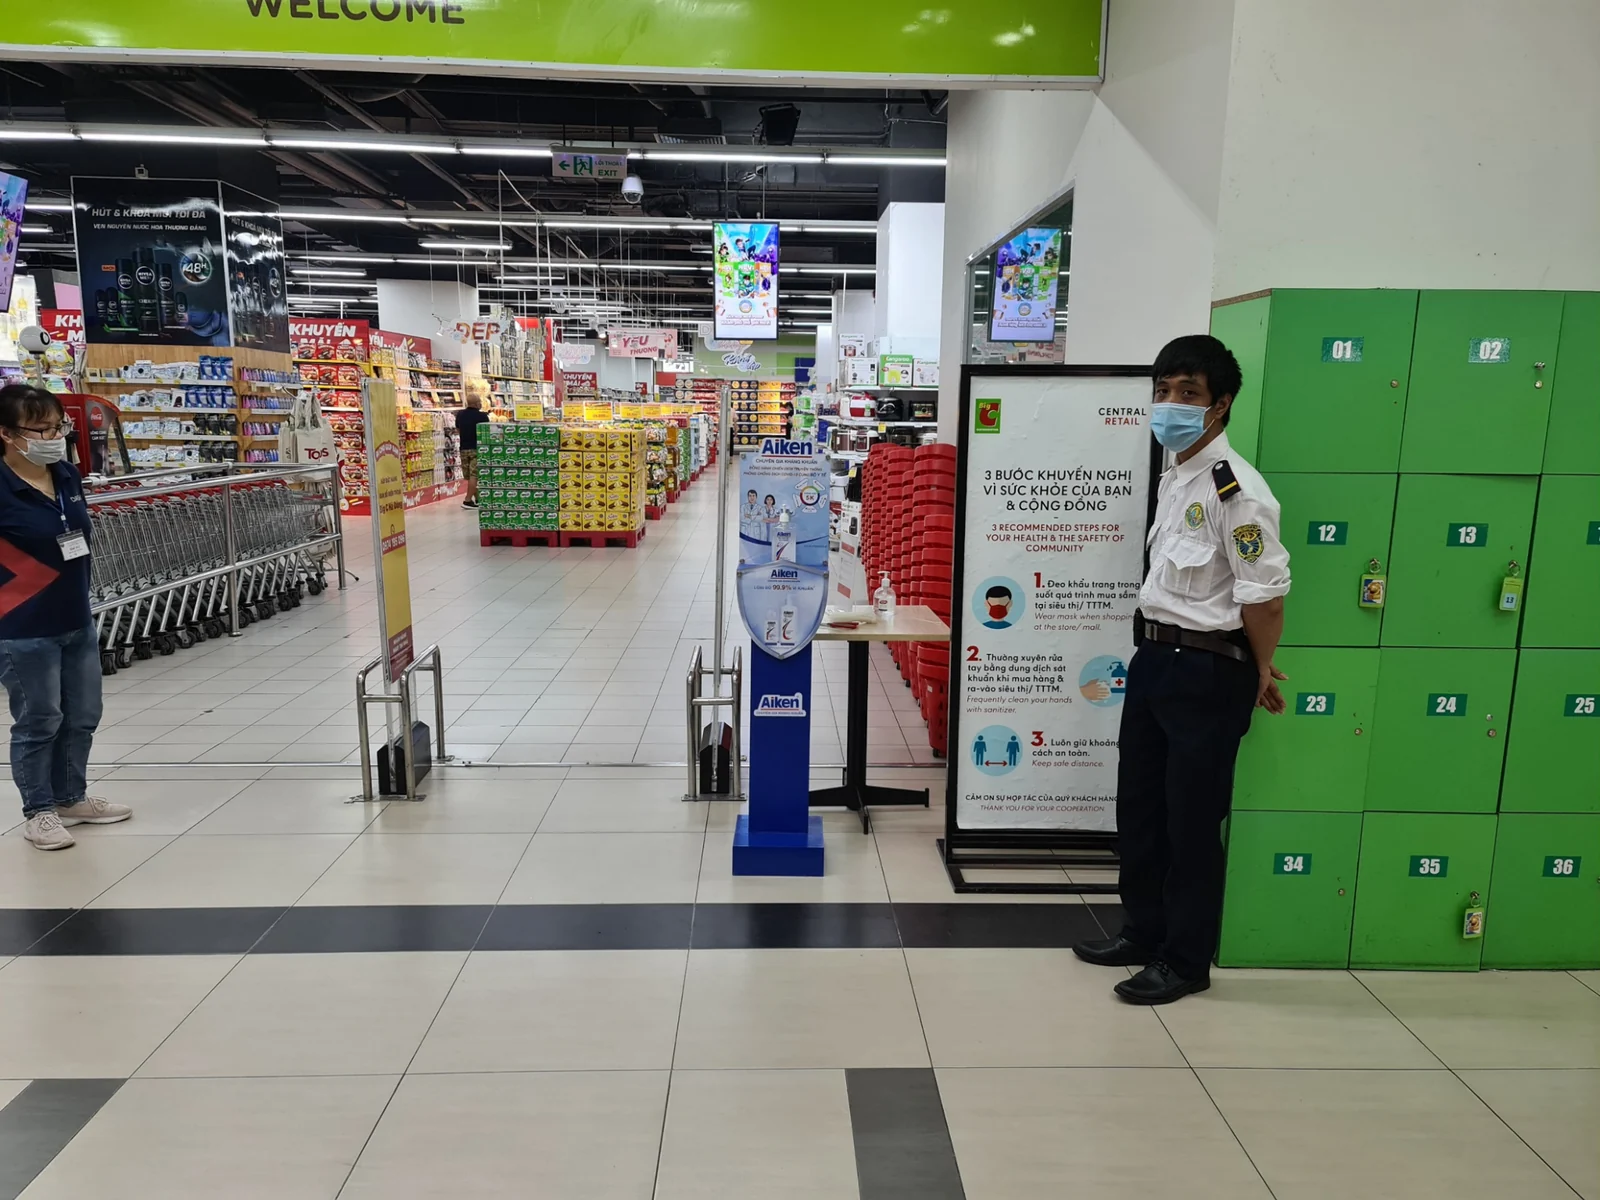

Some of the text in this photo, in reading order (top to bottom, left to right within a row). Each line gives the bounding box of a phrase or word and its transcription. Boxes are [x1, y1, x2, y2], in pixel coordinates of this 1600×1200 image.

[246, 0, 465, 24] WELCOME
[1332, 340, 1352, 359] 01
[1479, 341, 1502, 360] 02
[1098, 408, 1147, 416] CENTRAL
[1105, 417, 1140, 425] RETAIL
[762, 438, 813, 455] Aiken
[984, 465, 1132, 483] 3 BƯỚC KHUYẾN NGHỊ
[983, 482, 1132, 499] VÌ SỨC KHỎE CỦA BẠN
[1006, 500, 1015, 511] &
[1019, 498, 1060, 513] CỘNG
[1318, 524, 1336, 542] 12
[1458, 526, 1477, 543] 13
[771, 569, 798, 577] Aiken
[1034, 572, 1045, 588] 1.
[1068, 578, 1089, 588] khẩu
[1092, 581, 1114, 590] trang
[1118, 581, 1140, 590] trong
[1036, 590, 1053, 598] suốt
[1056, 591, 1072, 600] quá
[1035, 602, 1046, 611] tại
[1068, 601, 1084, 611] thị/
[966, 646, 982, 661] 2.
[986, 654, 1019, 663] Thường
[1021, 654, 1046, 663] xuyên
[984, 663, 1006, 673] bằng
[1008, 665, 1030, 673] dung
[1033, 665, 1051, 673] dịch
[968, 673, 994, 682] khuẩn
[1033, 675, 1055, 684] hàng
[1018, 685, 1033, 694] thị/
[761, 696, 799, 708] Aiken
[966, 695, 1006, 704] Frequently
[1306, 695, 1327, 712] 23
[1436, 697, 1457, 713] 24
[1574, 697, 1595, 714] 25
[1031, 731, 1047, 746] 3.
[1074, 739, 1087, 748] giữ
[1283, 856, 1303, 872] 34
[1419, 858, 1440, 875] 35
[1553, 858, 1574, 875] 36
